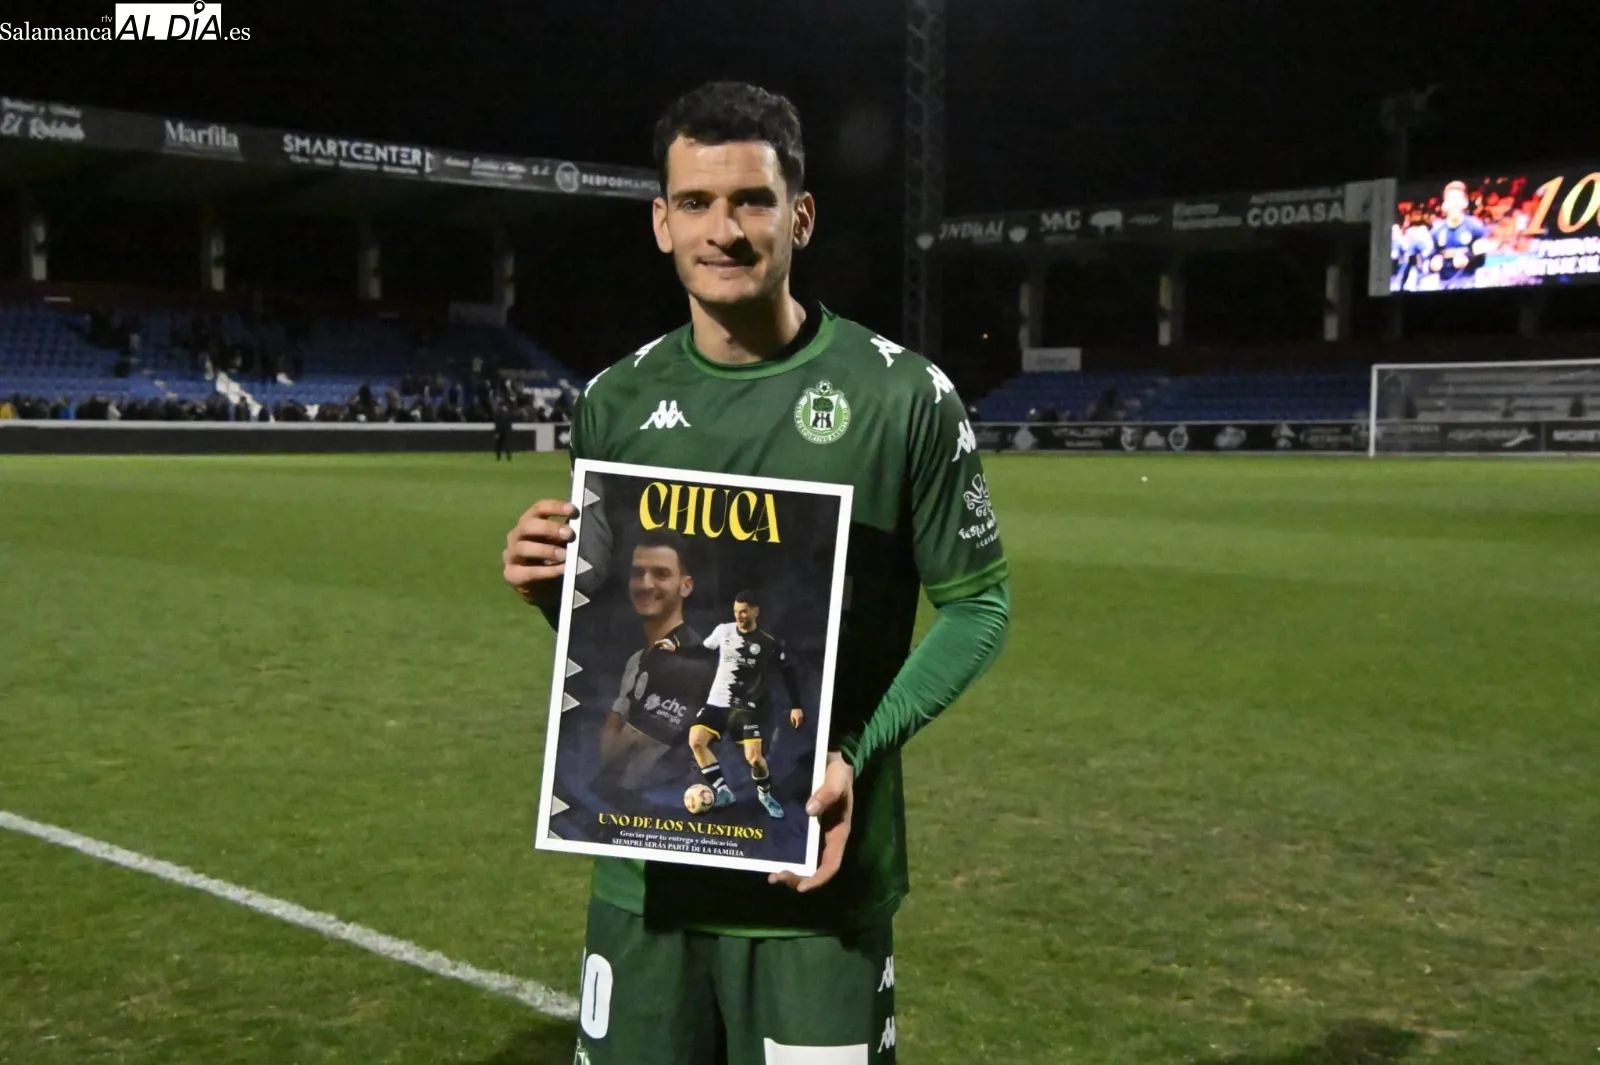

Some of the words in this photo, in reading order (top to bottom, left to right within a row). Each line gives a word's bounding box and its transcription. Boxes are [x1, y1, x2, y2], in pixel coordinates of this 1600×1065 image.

[164, 120, 240, 150] Marfila
[283, 134, 422, 166] SMARTCENTER
[1247, 202, 1344, 227] CODASA
[639, 481, 781, 543] CHUCA
[661, 697, 688, 717] chc
[598, 813, 630, 827] UNO
[633, 816, 652, 829] DE
[655, 818, 683, 832] LOS
[687, 821, 763, 839] NUESTROS
[619, 829, 645, 839] Gracias
[646, 833, 658, 841] por
[659, 833, 667, 841] tu
[668, 836, 694, 845] entrega
[700, 837, 738, 848] dedicación
[611, 837, 643, 847] SIEMPRE
[644, 838, 667, 849] SERÁS
[667, 842, 691, 852] PARTE
[691, 844, 702, 853] DE
[702, 846, 713, 854] LA
[713, 847, 745, 857] FAMILIA
[578, 946, 613, 1040] 0
